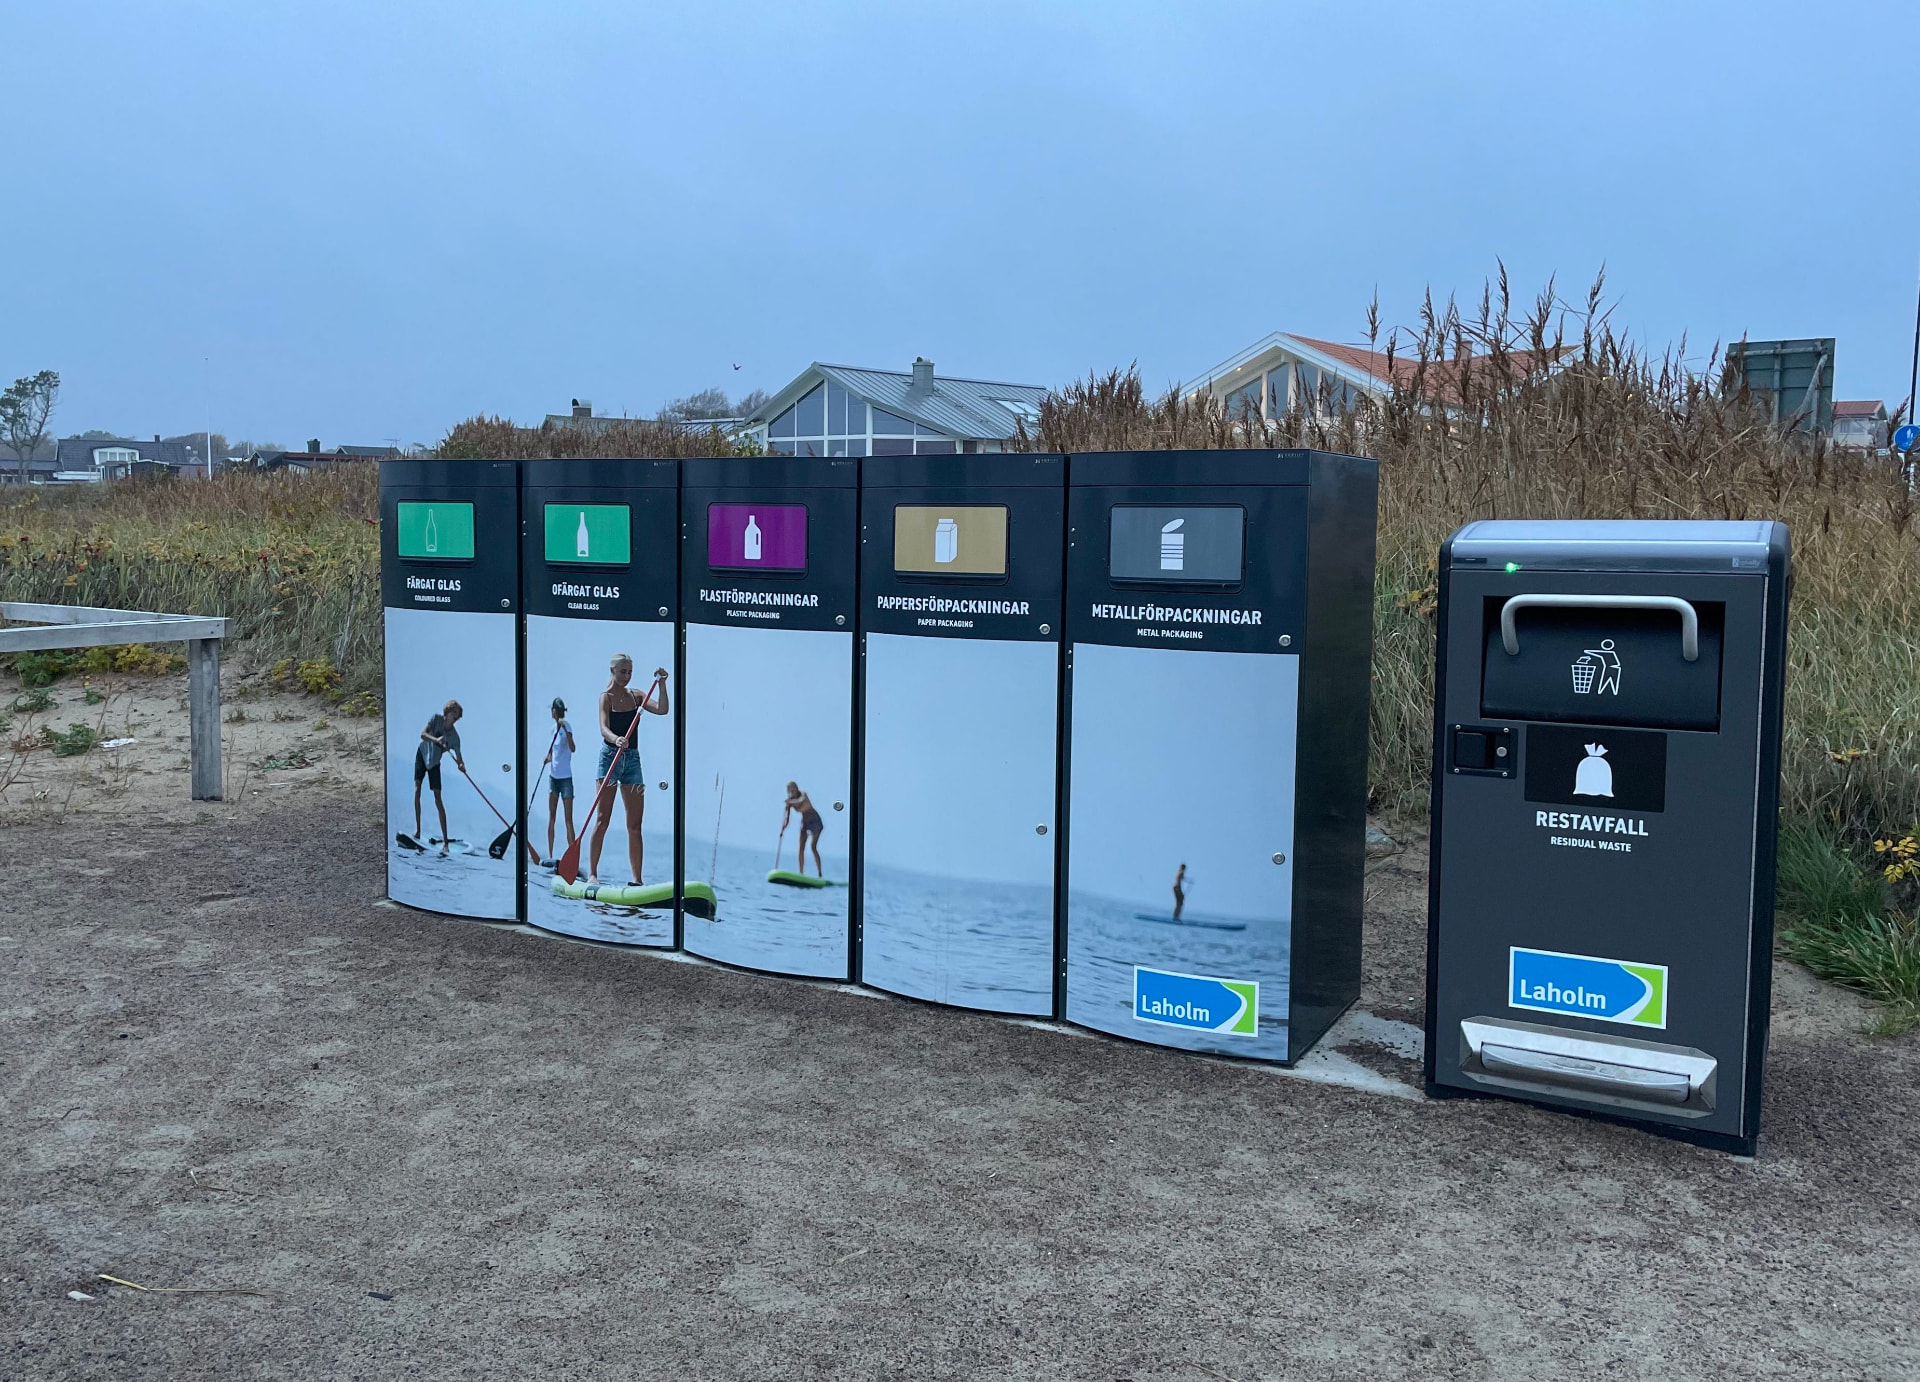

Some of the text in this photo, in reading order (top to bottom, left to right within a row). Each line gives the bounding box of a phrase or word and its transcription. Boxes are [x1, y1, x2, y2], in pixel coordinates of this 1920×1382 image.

[407, 576, 461, 592] FÄRGAT GLAS
[552, 582, 620, 599] OFÄRGAT GLAS
[700, 588, 819, 607] PLASTFÖRPACKNINGAR
[877, 596, 1029, 615] PAPPERSFÖRPACKNINGAR
[568, 602, 600, 611] CLEAR GLASS
[727, 609, 780, 620] PLASTIC PACKAGING
[1091, 603, 1262, 625] METALLFÖRPACKNINGAR
[917, 618, 974, 628] PAPER PACKAGING
[1137, 628, 1203, 639] METAL PACKAGING
[1536, 811, 1648, 836] RESTAVFALL
[1550, 836, 1632, 852] RESIDUAL WASTE
[1519, 979, 1607, 1010] Laholm
[1141, 994, 1210, 1023] Laholm
